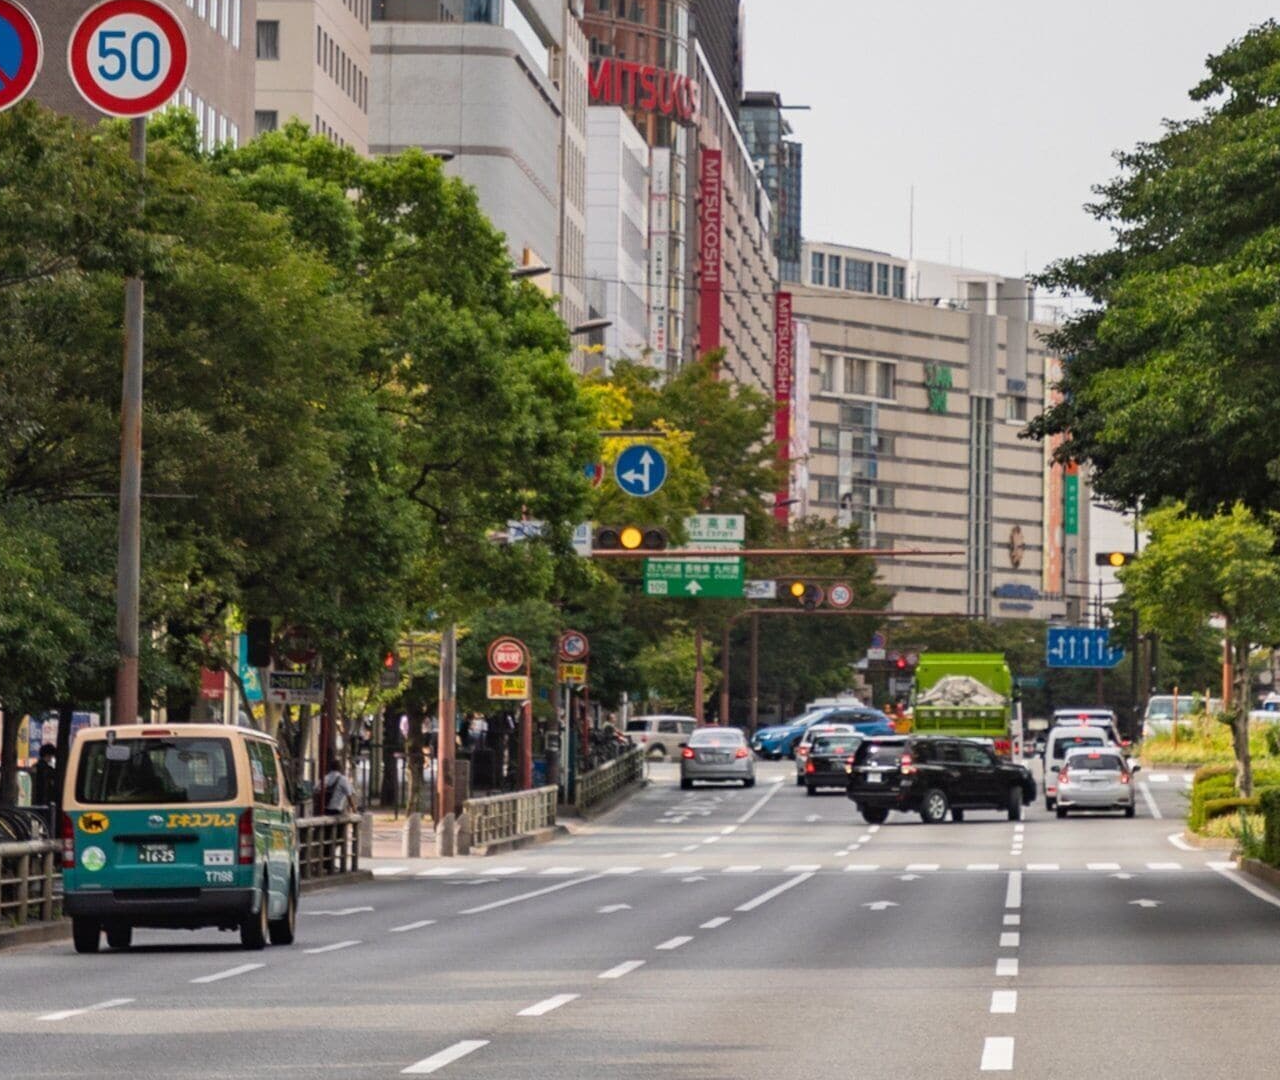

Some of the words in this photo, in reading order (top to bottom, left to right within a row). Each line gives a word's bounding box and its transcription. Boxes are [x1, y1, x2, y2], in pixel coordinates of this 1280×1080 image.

[98, 30, 160, 82] 50
[704, 158, 720, 283] MITSUKOSHI
[777, 299, 790, 394] MITSUKOSHI
[166, 813, 237, 828] エキスプレス
